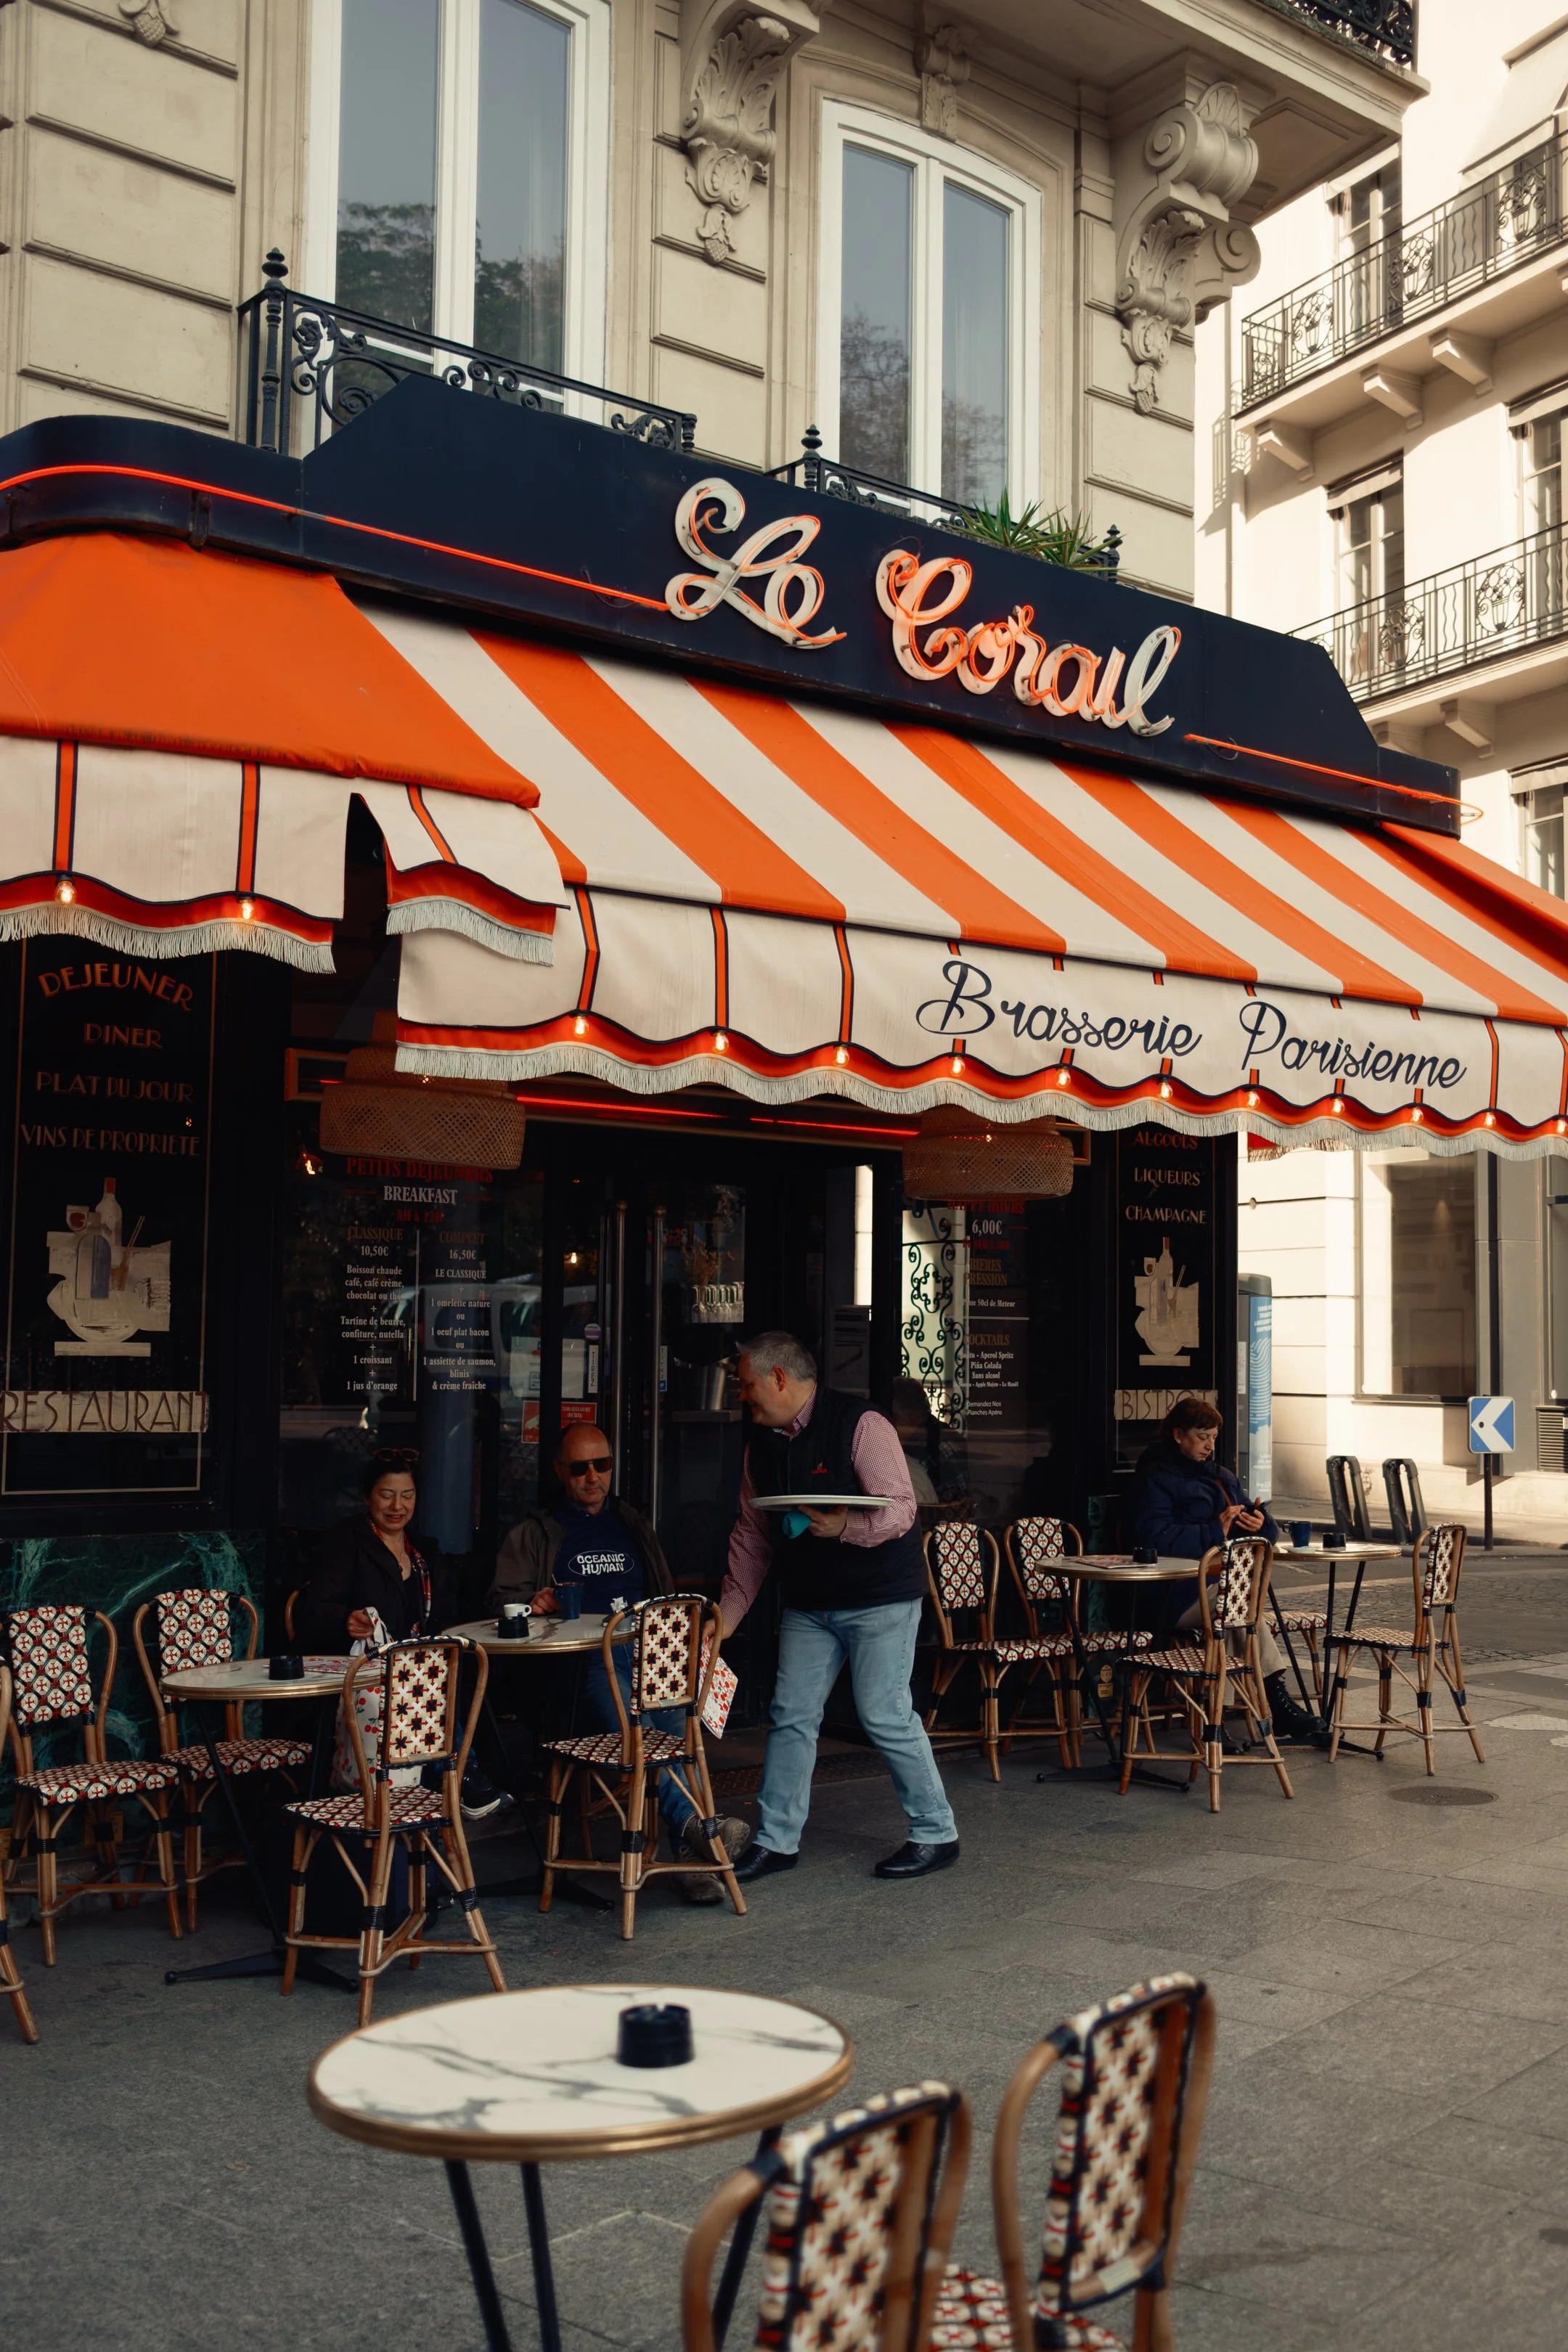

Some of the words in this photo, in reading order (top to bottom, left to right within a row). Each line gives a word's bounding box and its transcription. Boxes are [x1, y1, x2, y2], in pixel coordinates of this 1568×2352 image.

[664, 477, 846, 650] Le
[874, 546, 1182, 737] Coral
[37, 963, 194, 1012] DEJEUNER
[915, 960, 1202, 1057] Brasserie
[1238, 1000, 1467, 1087] Parisienne
[84, 1022, 163, 1049] DINER
[36, 1071, 102, 1096] PLAT
[105, 1077, 130, 1098] DU
[134, 1079, 194, 1103] JOUR
[20, 1123, 69, 1147] VINS
[72, 1127, 95, 1150] DE
[99, 1129, 201, 1156] PROPRIETE
[1132, 1130, 1199, 1150] ALCOOLS
[346, 1157, 401, 1177] PETITS
[1134, 1167, 1201, 1187] LIQUEURS
[383, 1185, 458, 1204] BREAKFAST
[1125, 1205, 1206, 1224] CHAMPAGNE
[347, 1226, 403, 1242] CLASSIQUE
[972, 1220, 1003, 1236] 6,00€
[438, 1230, 486, 1245] COMPLET
[360, 1245, 389, 1257] 10,50€
[449, 1249, 476, 1262] 16,50€
[346, 1265, 375, 1275] Boisson
[377, 1266, 402, 1275] chaude
[970, 1258, 1002, 1271] BIERES
[436, 1269, 445, 1278] LE
[446, 1269, 486, 1280] CLASSIQUE
[963, 1273, 1008, 1286] PRESSION
[345, 1278, 362, 1289] café,
[364, 1278, 379, 1287] café
[380, 1278, 404, 1289] crème,
[346, 1291, 377, 1301] chocolat
[430, 1299, 434, 1307] 1
[437, 1299, 467, 1307] omelette
[340, 1315, 367, 1326] Tartine
[369, 1316, 377, 1326] de
[380, 1316, 406, 1328] beurre,
[341, 1328, 377, 1340] confiture,
[379, 1329, 404, 1339] nutella
[437, 1327, 452, 1336] oeuf
[454, 1328, 467, 1338] plat
[469, 1327, 489, 1336] bacon
[963, 1334, 1010, 1346] COCKTAILS
[359, 1355, 392, 1364] croissant
[429, 1357, 455, 1365] assiette
[457, 1357, 466, 1365] de
[467, 1358, 496, 1367] saumon,
[980, 1351, 997, 1360] Aperol
[998, 1351, 1014, 1360] Spritz
[450, 1369, 470, 1378] blinis
[346, 1381, 350, 1390] 1
[352, 1381, 364, 1392] jus
[432, 1381, 438, 1390] &
[439, 1381, 460, 1390] crème
[462, 1381, 486, 1390] fraîche
[1, 1391, 207, 1432] RESTAURANT
[576, 1553, 626, 1564] OCEANIC
[581, 1562, 624, 1575] HUMAN
